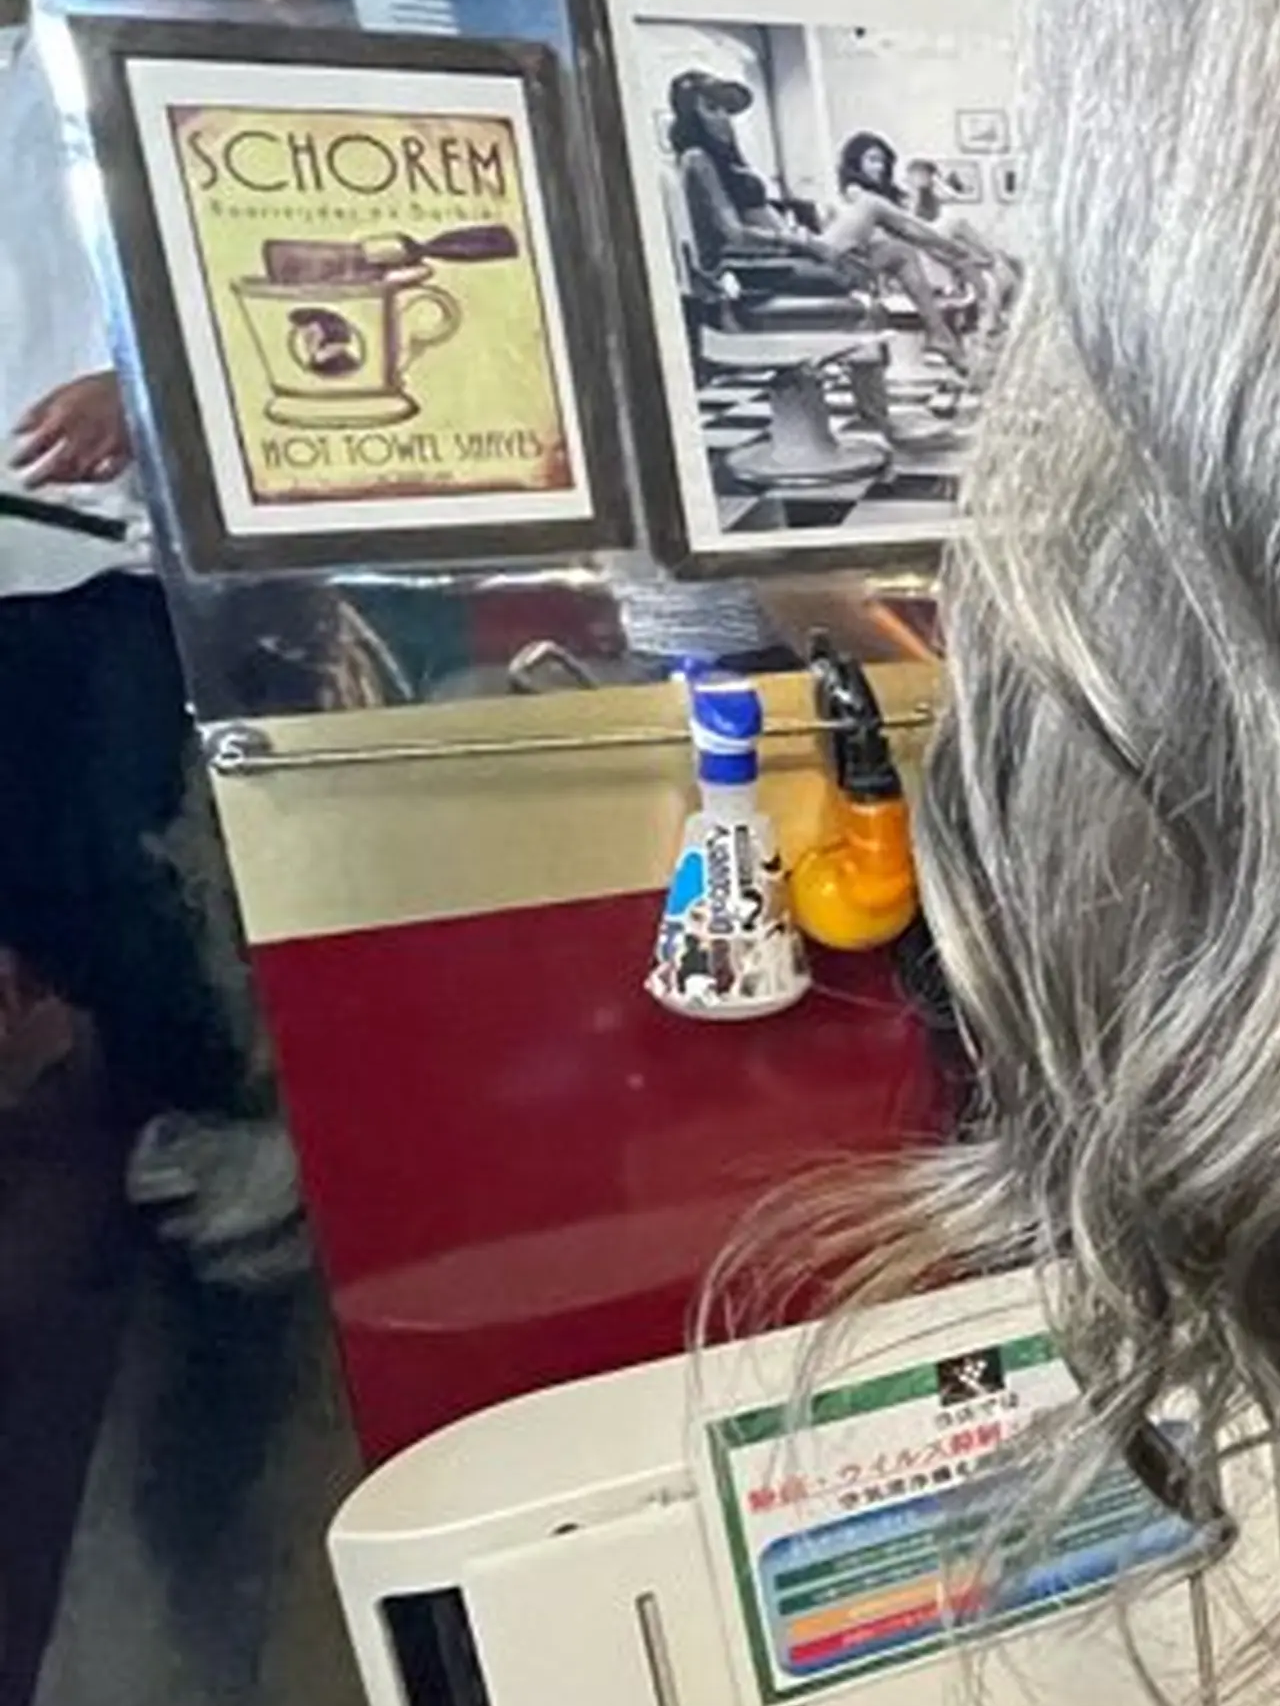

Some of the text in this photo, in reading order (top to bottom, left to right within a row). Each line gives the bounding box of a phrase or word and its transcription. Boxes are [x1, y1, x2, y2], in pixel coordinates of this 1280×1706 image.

[187, 128, 507, 197] SCHOREM
[262, 427, 545, 469] HOT TOWEL SHAVES
